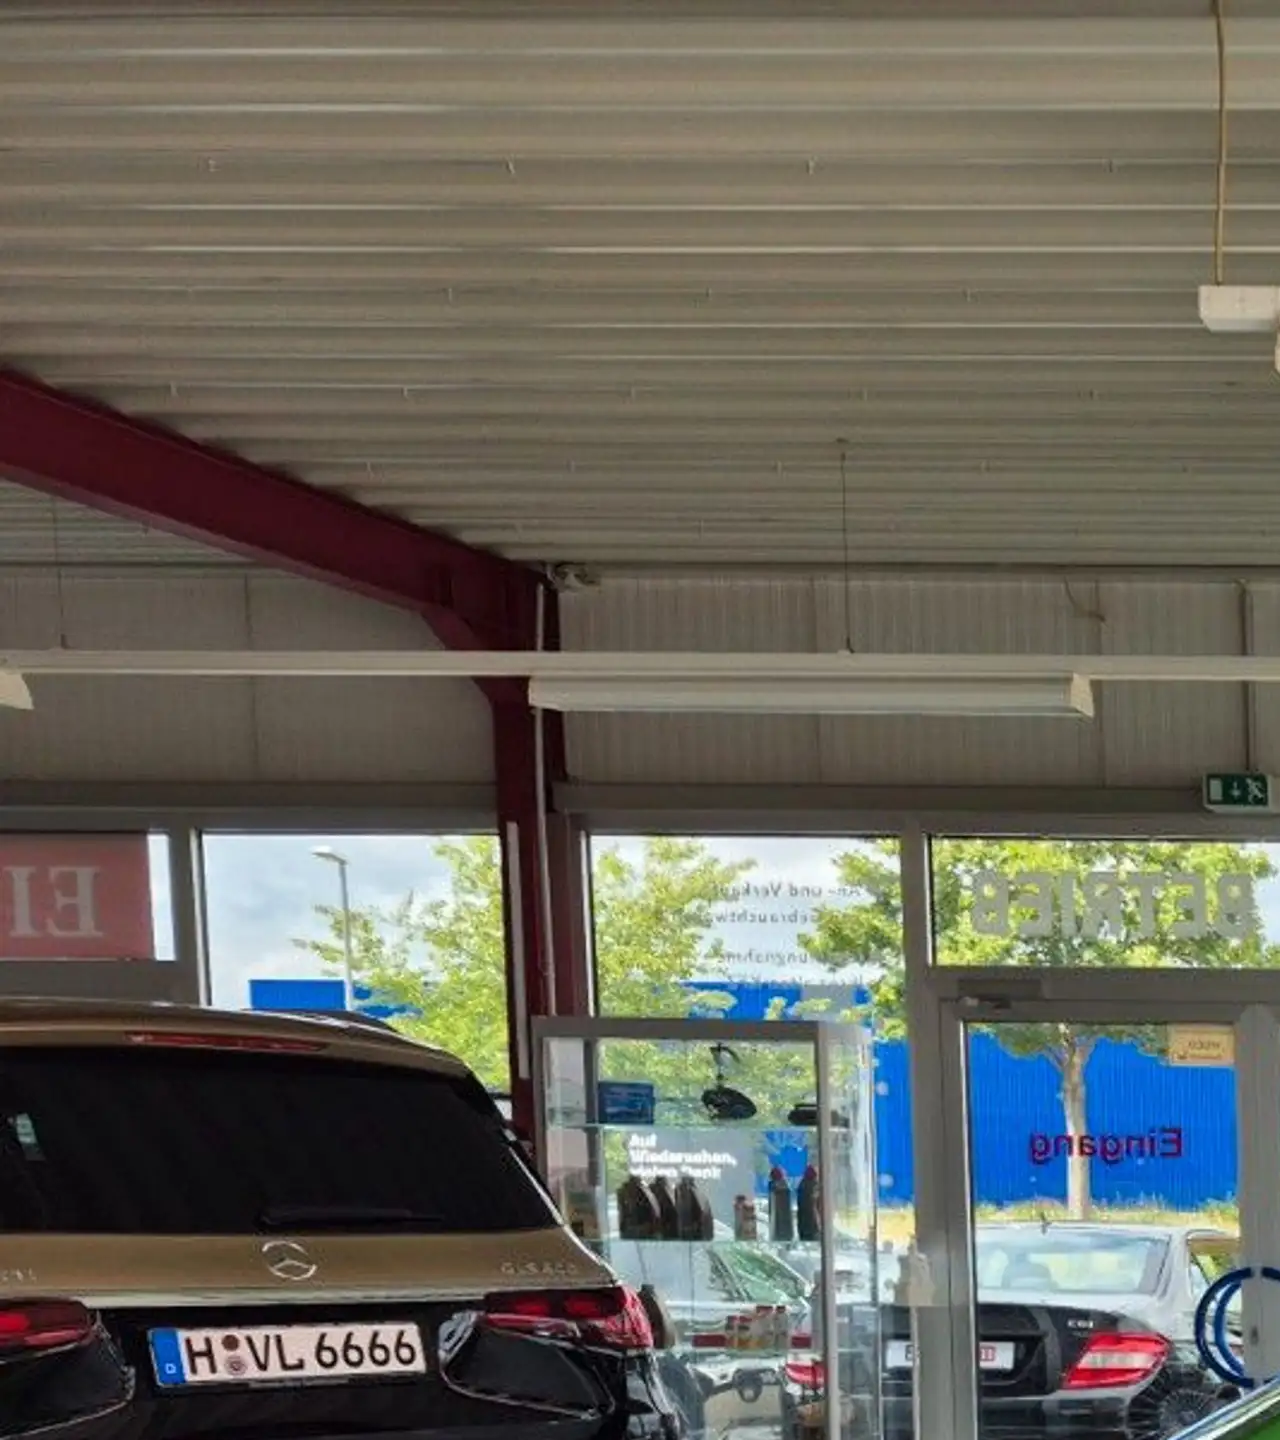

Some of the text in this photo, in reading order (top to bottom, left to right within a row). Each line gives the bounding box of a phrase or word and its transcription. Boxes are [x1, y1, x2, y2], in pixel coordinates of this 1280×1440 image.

[184, 1335, 217, 1376] H
[244, 1332, 306, 1373] VL
[314, 1329, 417, 1370] 6666
